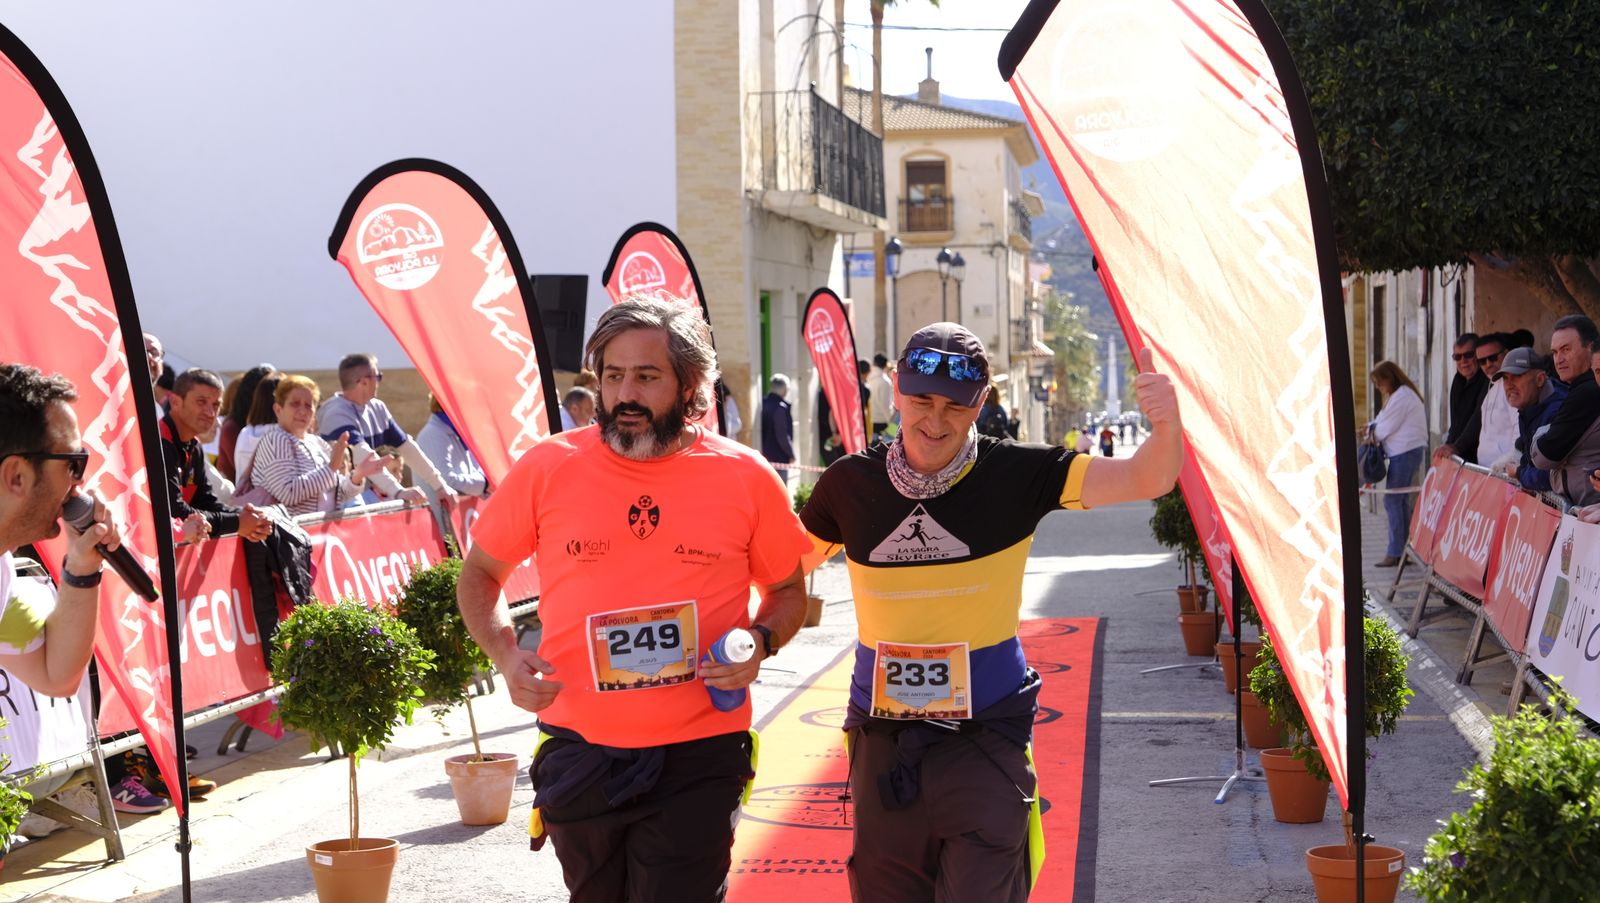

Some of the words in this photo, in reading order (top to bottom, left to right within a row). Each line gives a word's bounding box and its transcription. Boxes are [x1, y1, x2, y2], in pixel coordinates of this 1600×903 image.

[583, 539, 610, 551] Kohl
[886, 553, 950, 561] SkyRace
[608, 623, 680, 656] 249
[886, 661, 950, 687] 233
[115, 789, 136, 804] N
